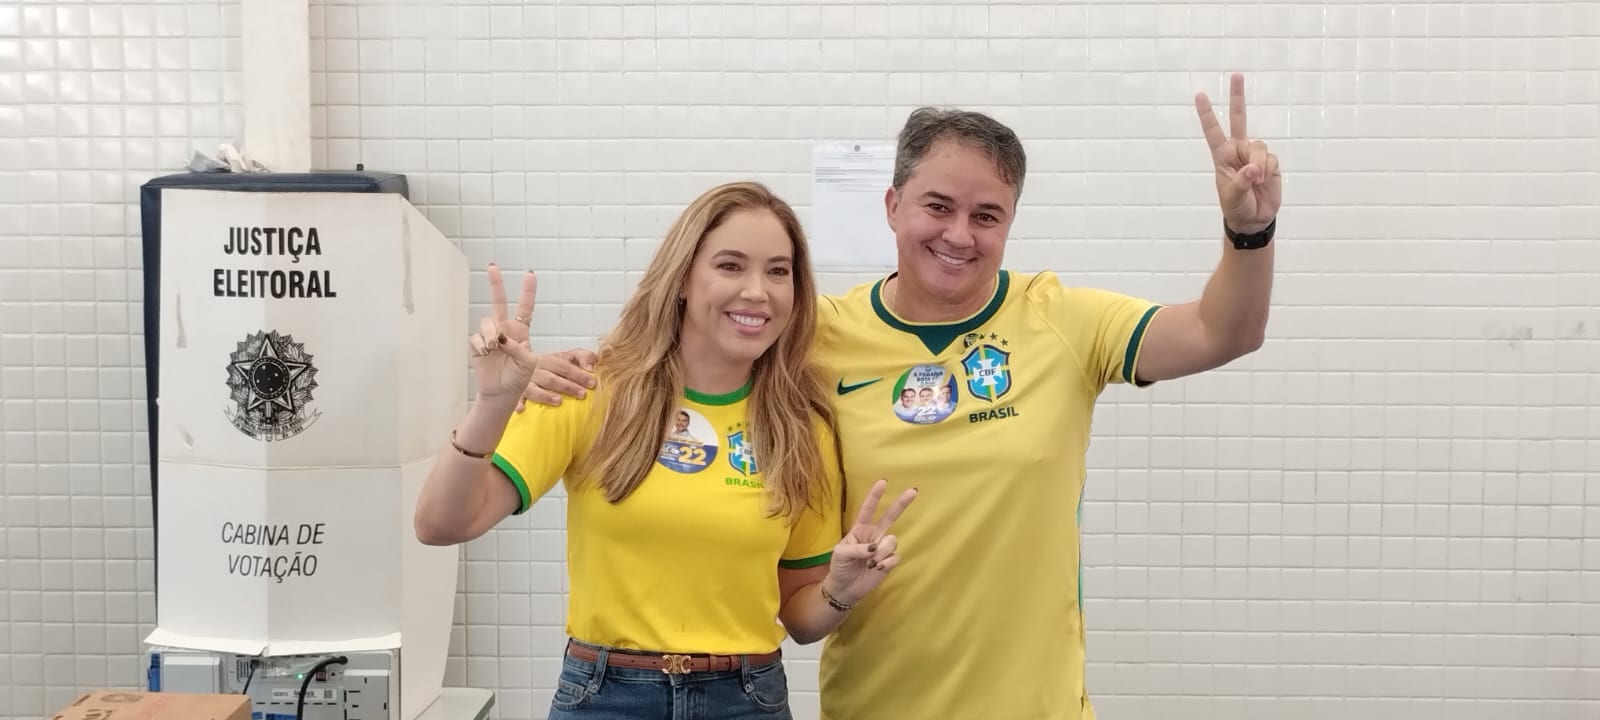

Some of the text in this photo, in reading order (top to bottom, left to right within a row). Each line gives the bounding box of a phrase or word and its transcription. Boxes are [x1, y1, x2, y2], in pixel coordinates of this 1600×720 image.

[223, 226, 322, 263] JUSTIÇA
[213, 268, 337, 299] ELEITORAL
[979, 369, 996, 377] CBF
[917, 406, 937, 416] 22
[969, 406, 1019, 423] BRASIL
[678, 445, 707, 466] 22
[221, 521, 326, 546] CABINA DE
[228, 551, 318, 584] VOTAÇÃO
